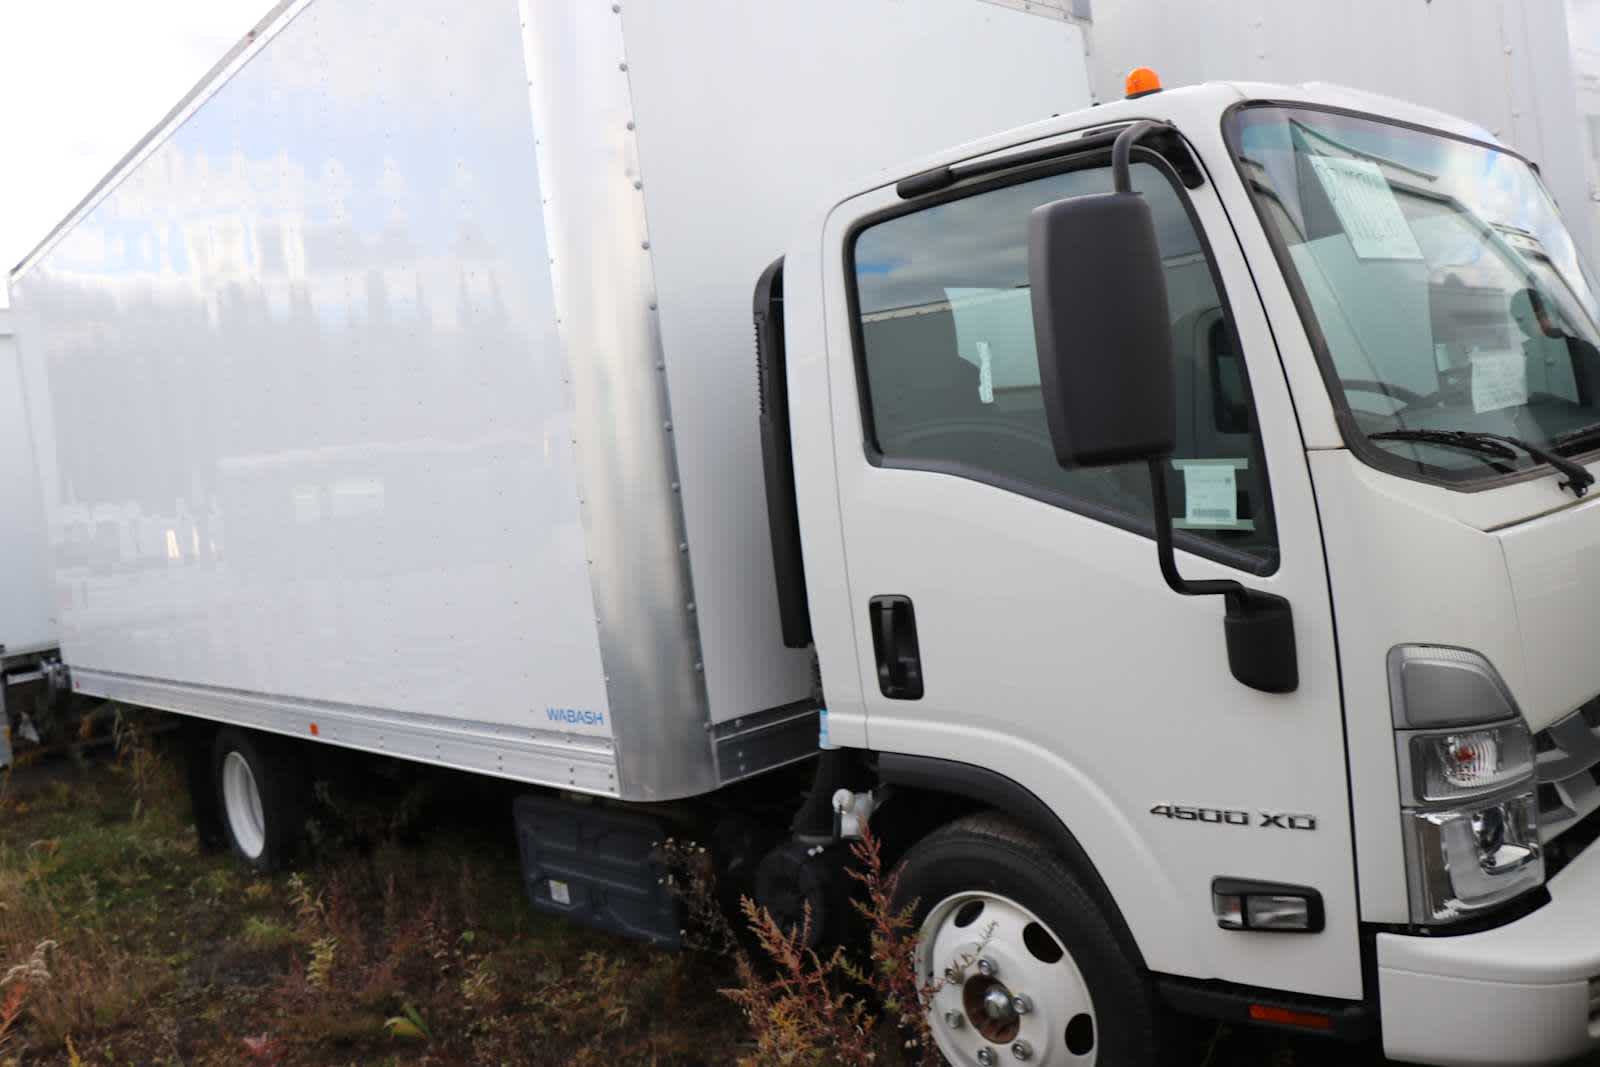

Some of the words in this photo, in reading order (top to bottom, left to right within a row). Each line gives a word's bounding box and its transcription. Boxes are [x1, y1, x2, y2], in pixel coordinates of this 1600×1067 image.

[546, 707, 604, 726] WABASH
[1150, 804, 1249, 826] 4500
[1259, 813, 1316, 831] XD
